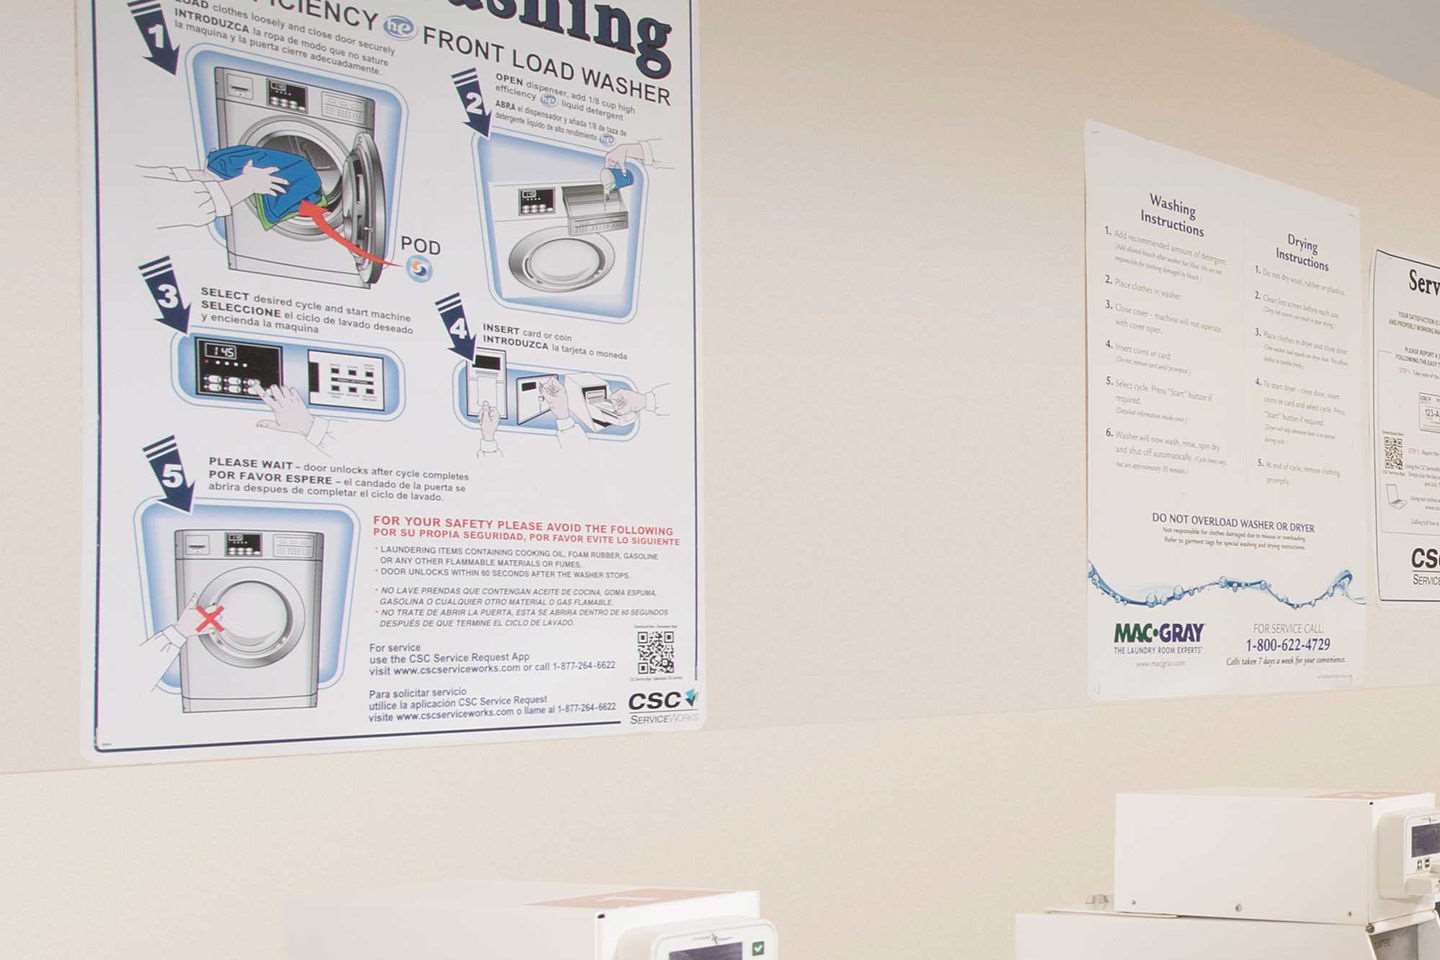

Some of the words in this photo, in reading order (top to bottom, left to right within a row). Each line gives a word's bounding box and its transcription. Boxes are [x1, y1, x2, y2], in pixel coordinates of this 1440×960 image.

[148, 24, 165, 48] 1
[212, 4, 248, 19] clothes
[251, 11, 284, 29] loosely
[288, 23, 305, 32] and
[307, 27, 332, 39] close
[334, 33, 356, 45] door
[358, 40, 394, 55] securely
[424, 26, 504, 62] FRONT
[512, 50, 574, 79] LOAD
[581, 68, 672, 104] WASHER
[466, 92, 483, 114] 2
[1150, 192, 1196, 221] Washing
[1105, 225, 1112, 236] 1.
[1141, 209, 1204, 237] Instructions
[401, 236, 441, 257] POD
[1288, 233, 1318, 255] Drying
[1276, 247, 1329, 272] Instructions
[1105, 274, 1113, 285] 2.
[158, 284, 179, 310] 3
[201, 287, 250, 300] SELECT
[253, 294, 292, 306] desired
[295, 301, 321, 310] cycle
[325, 305, 342, 313] and
[346, 307, 368, 316] start
[371, 311, 410, 321] machine
[1105, 299, 1113, 310] 3.
[201, 301, 281, 317] SELECCIONE
[284, 311, 292, 319] el
[296, 313, 320, 322] ciclo
[323, 316, 335, 325] de
[338, 318, 370, 329] lavado
[373, 322, 413, 333] deseado
[448, 317, 469, 341] 4
[482, 335, 548, 349] INTRODUZCA
[551, 343, 559, 351] la
[561, 345, 586, 354] tarjeta
[596, 350, 627, 359] moneda
[1105, 339, 1113, 349] 4.
[1106, 375, 1114, 386] 5.
[1106, 427, 1114, 438] 6.
[160, 464, 184, 489] 5
[208, 457, 258, 467] PLEASE
[261, 460, 293, 469] WAIT
[302, 463, 328, 473] door
[329, 465, 368, 474] unlocks
[371, 467, 393, 475] after
[395, 470, 419, 478] cycle
[422, 472, 469, 481] completes
[208, 470, 235, 479] POR
[239, 472, 282, 481] FAVOR
[285, 474, 332, 484] ESPERE
[354, 480, 396, 488] candado
[398, 481, 410, 489] de
[413, 481, 421, 489] la
[373, 515, 400, 525] FOR
[404, 516, 440, 526] YOUR
[444, 518, 493, 528] SAFETY
[497, 520, 544, 530] PLEASE
[546, 522, 581, 532] AVOID
[584, 524, 607, 532] THE
[610, 525, 673, 535] FOLLOWING
[1152, 512, 1166, 522] DO
[1169, 514, 1188, 523] NOT
[1191, 515, 1238, 526] OVERLOAD
[1240, 519, 1274, 529] WASHER
[1276, 521, 1287, 530] OR
[1290, 522, 1314, 532] DRYER
[463, 531, 526, 541] SEGURIDAD,
[529, 533, 549, 541] POR
[552, 534, 583, 542] FAVOR
[586, 535, 613, 543] EVITE
[630, 537, 679, 545] SIGUIENTE
[369, 642, 385, 652] For
[387, 643, 420, 651] service
[1127, 646, 1155, 654] LAUNDRY
[1158, 646, 1175, 654] ROOM
[1177, 646, 1202, 654] EXPERTS
[1247, 638, 1330, 652] 1-800-622-4729
[369, 666, 391, 676] visit
[393, 664, 520, 675] www.cscserviceworks.com
[522, 662, 533, 671] or
[534, 662, 550, 670] call
[552, 660, 617, 670] 1-877-264-6622
[370, 656, 386, 666] use
[390, 655, 405, 663] the
[409, 654, 429, 662] CSC
[434, 654, 468, 664] Service
[472, 653, 508, 663] Request
[512, 652, 529, 662] App
[628, 691, 681, 711] CSC
